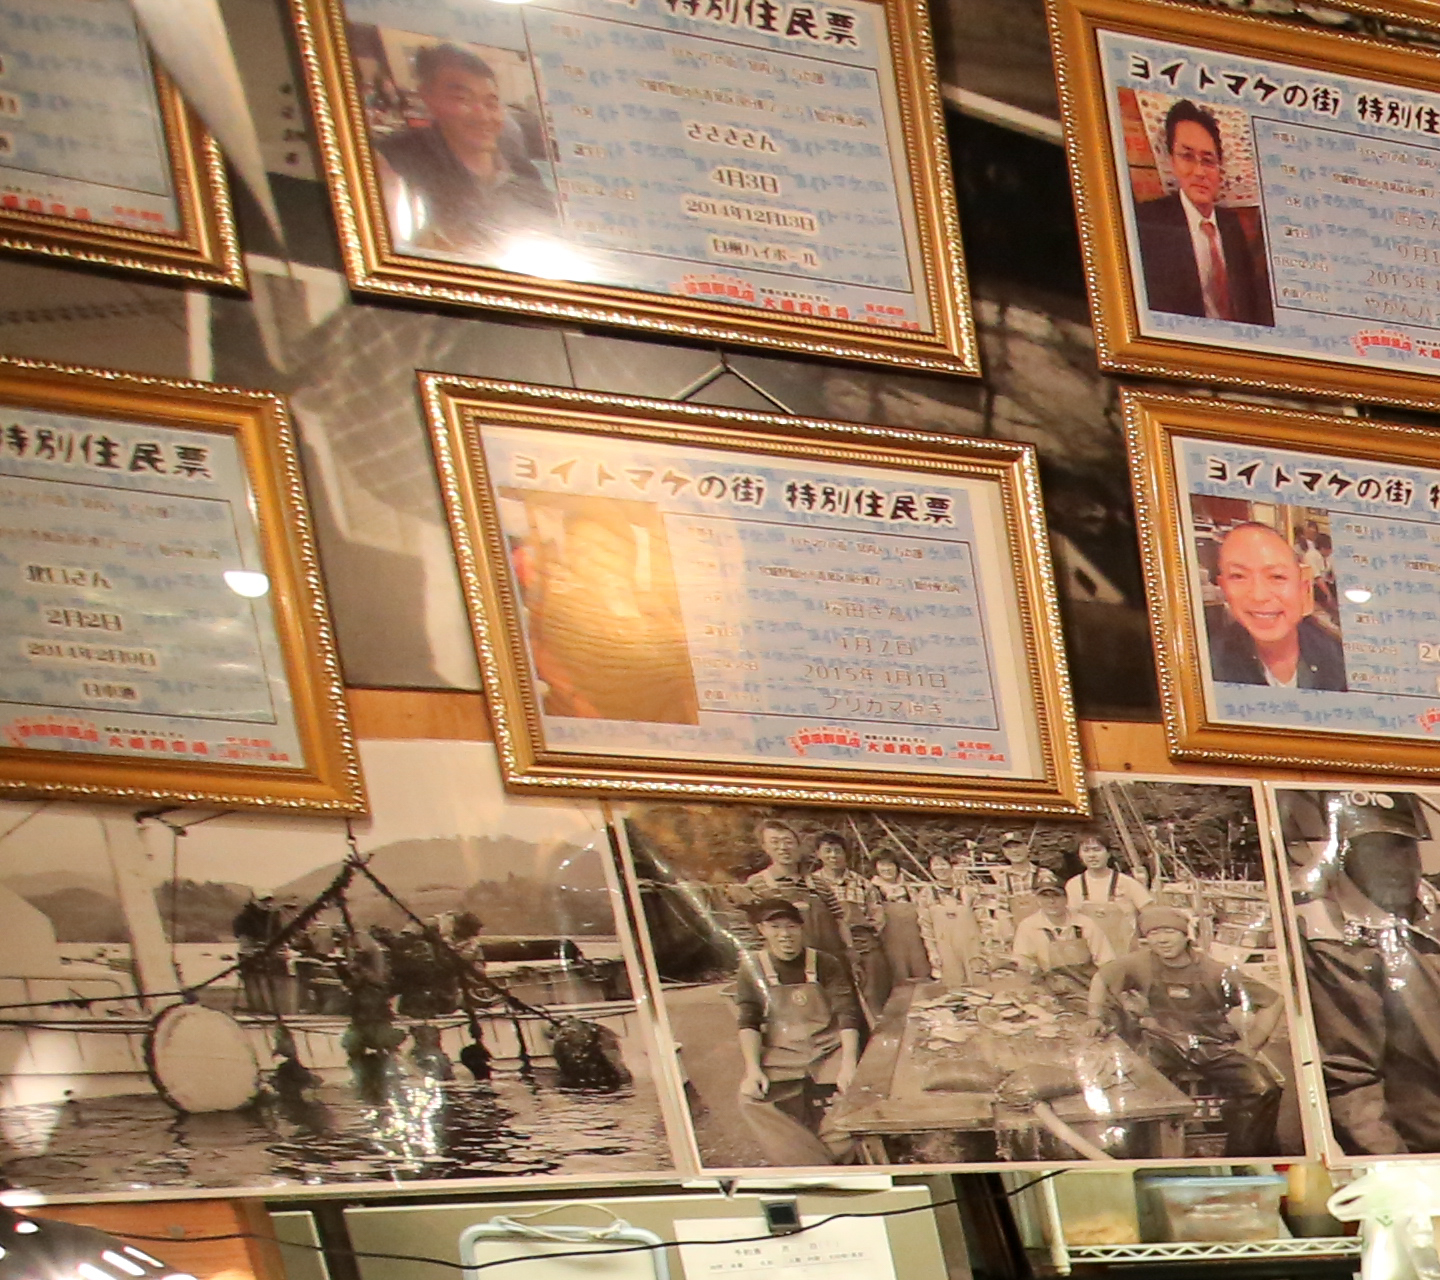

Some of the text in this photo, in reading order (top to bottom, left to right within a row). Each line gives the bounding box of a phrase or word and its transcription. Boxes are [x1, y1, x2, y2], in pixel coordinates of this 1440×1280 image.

[1130, 55, 1341, 116] ヨイトマケの街
[1208, 458, 1411, 505] ヨイトマケの街
[786, 483, 956, 527] 特別住民票
[1340, 789, 1394, 808] TOYO
